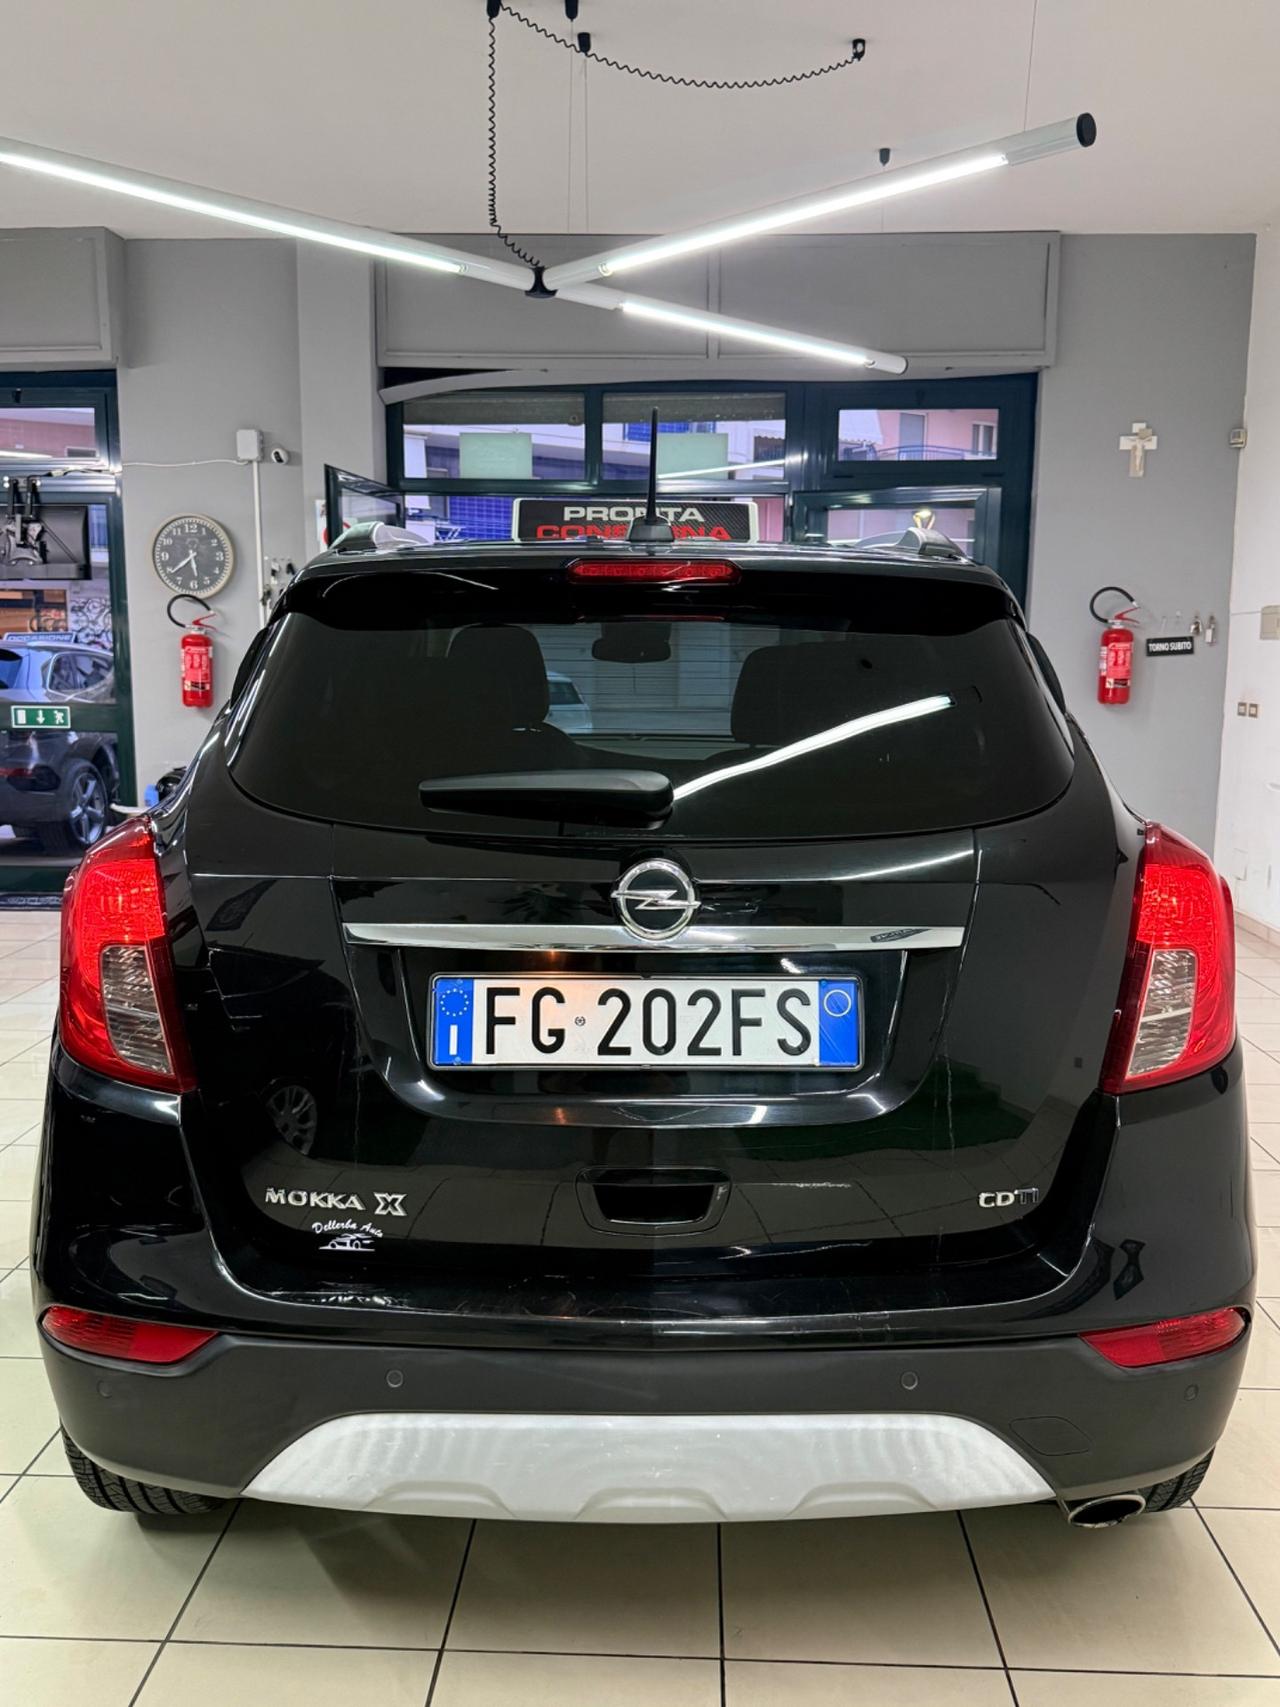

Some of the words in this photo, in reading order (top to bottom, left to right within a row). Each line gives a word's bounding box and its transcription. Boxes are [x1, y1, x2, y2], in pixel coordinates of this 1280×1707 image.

[184, 524, 198, 533] 12
[161, 551, 169, 561] 9
[215, 551, 224, 561] 3
[190, 580, 198, 589] 6
[1149, 642, 1169, 652] TORNO
[1170, 641, 1192, 651] SUBITO
[486, 986, 566, 1056] FG
[597, 987, 812, 1056] 202FS
[265, 1187, 366, 1211] MOKKA
[373, 1192, 407, 1217] X
[979, 1187, 1039, 1208] CDTI
